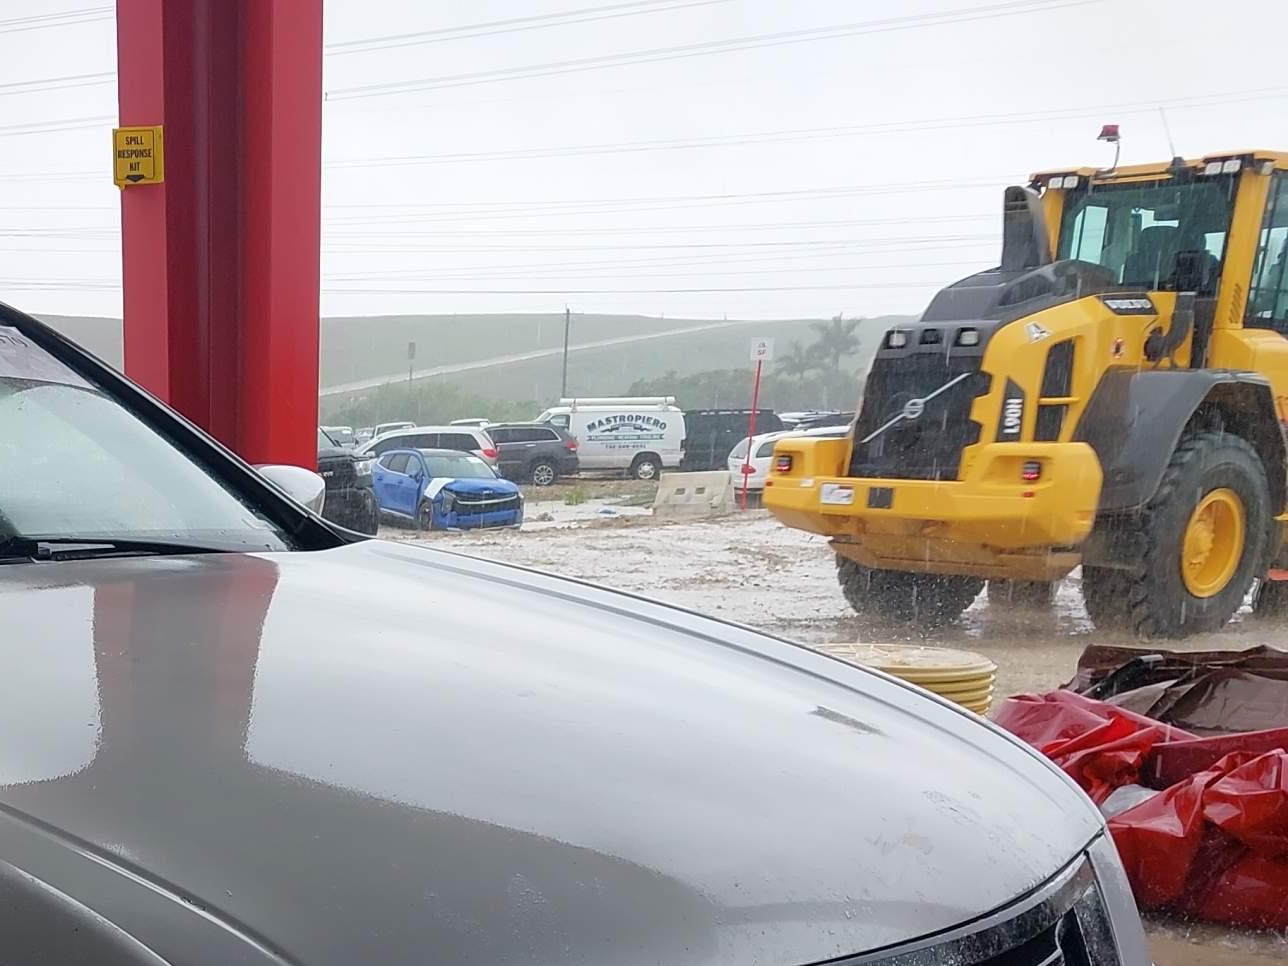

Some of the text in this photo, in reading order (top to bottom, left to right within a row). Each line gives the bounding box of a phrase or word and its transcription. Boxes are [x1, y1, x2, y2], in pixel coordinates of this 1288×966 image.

[125, 136, 144, 145] SPILL
[118, 149, 152, 159] RESPONSE
[129, 162, 140, 171] KIT
[1003, 398, 1024, 434] L90H
[586, 414, 667, 432] MASTROPIERO
